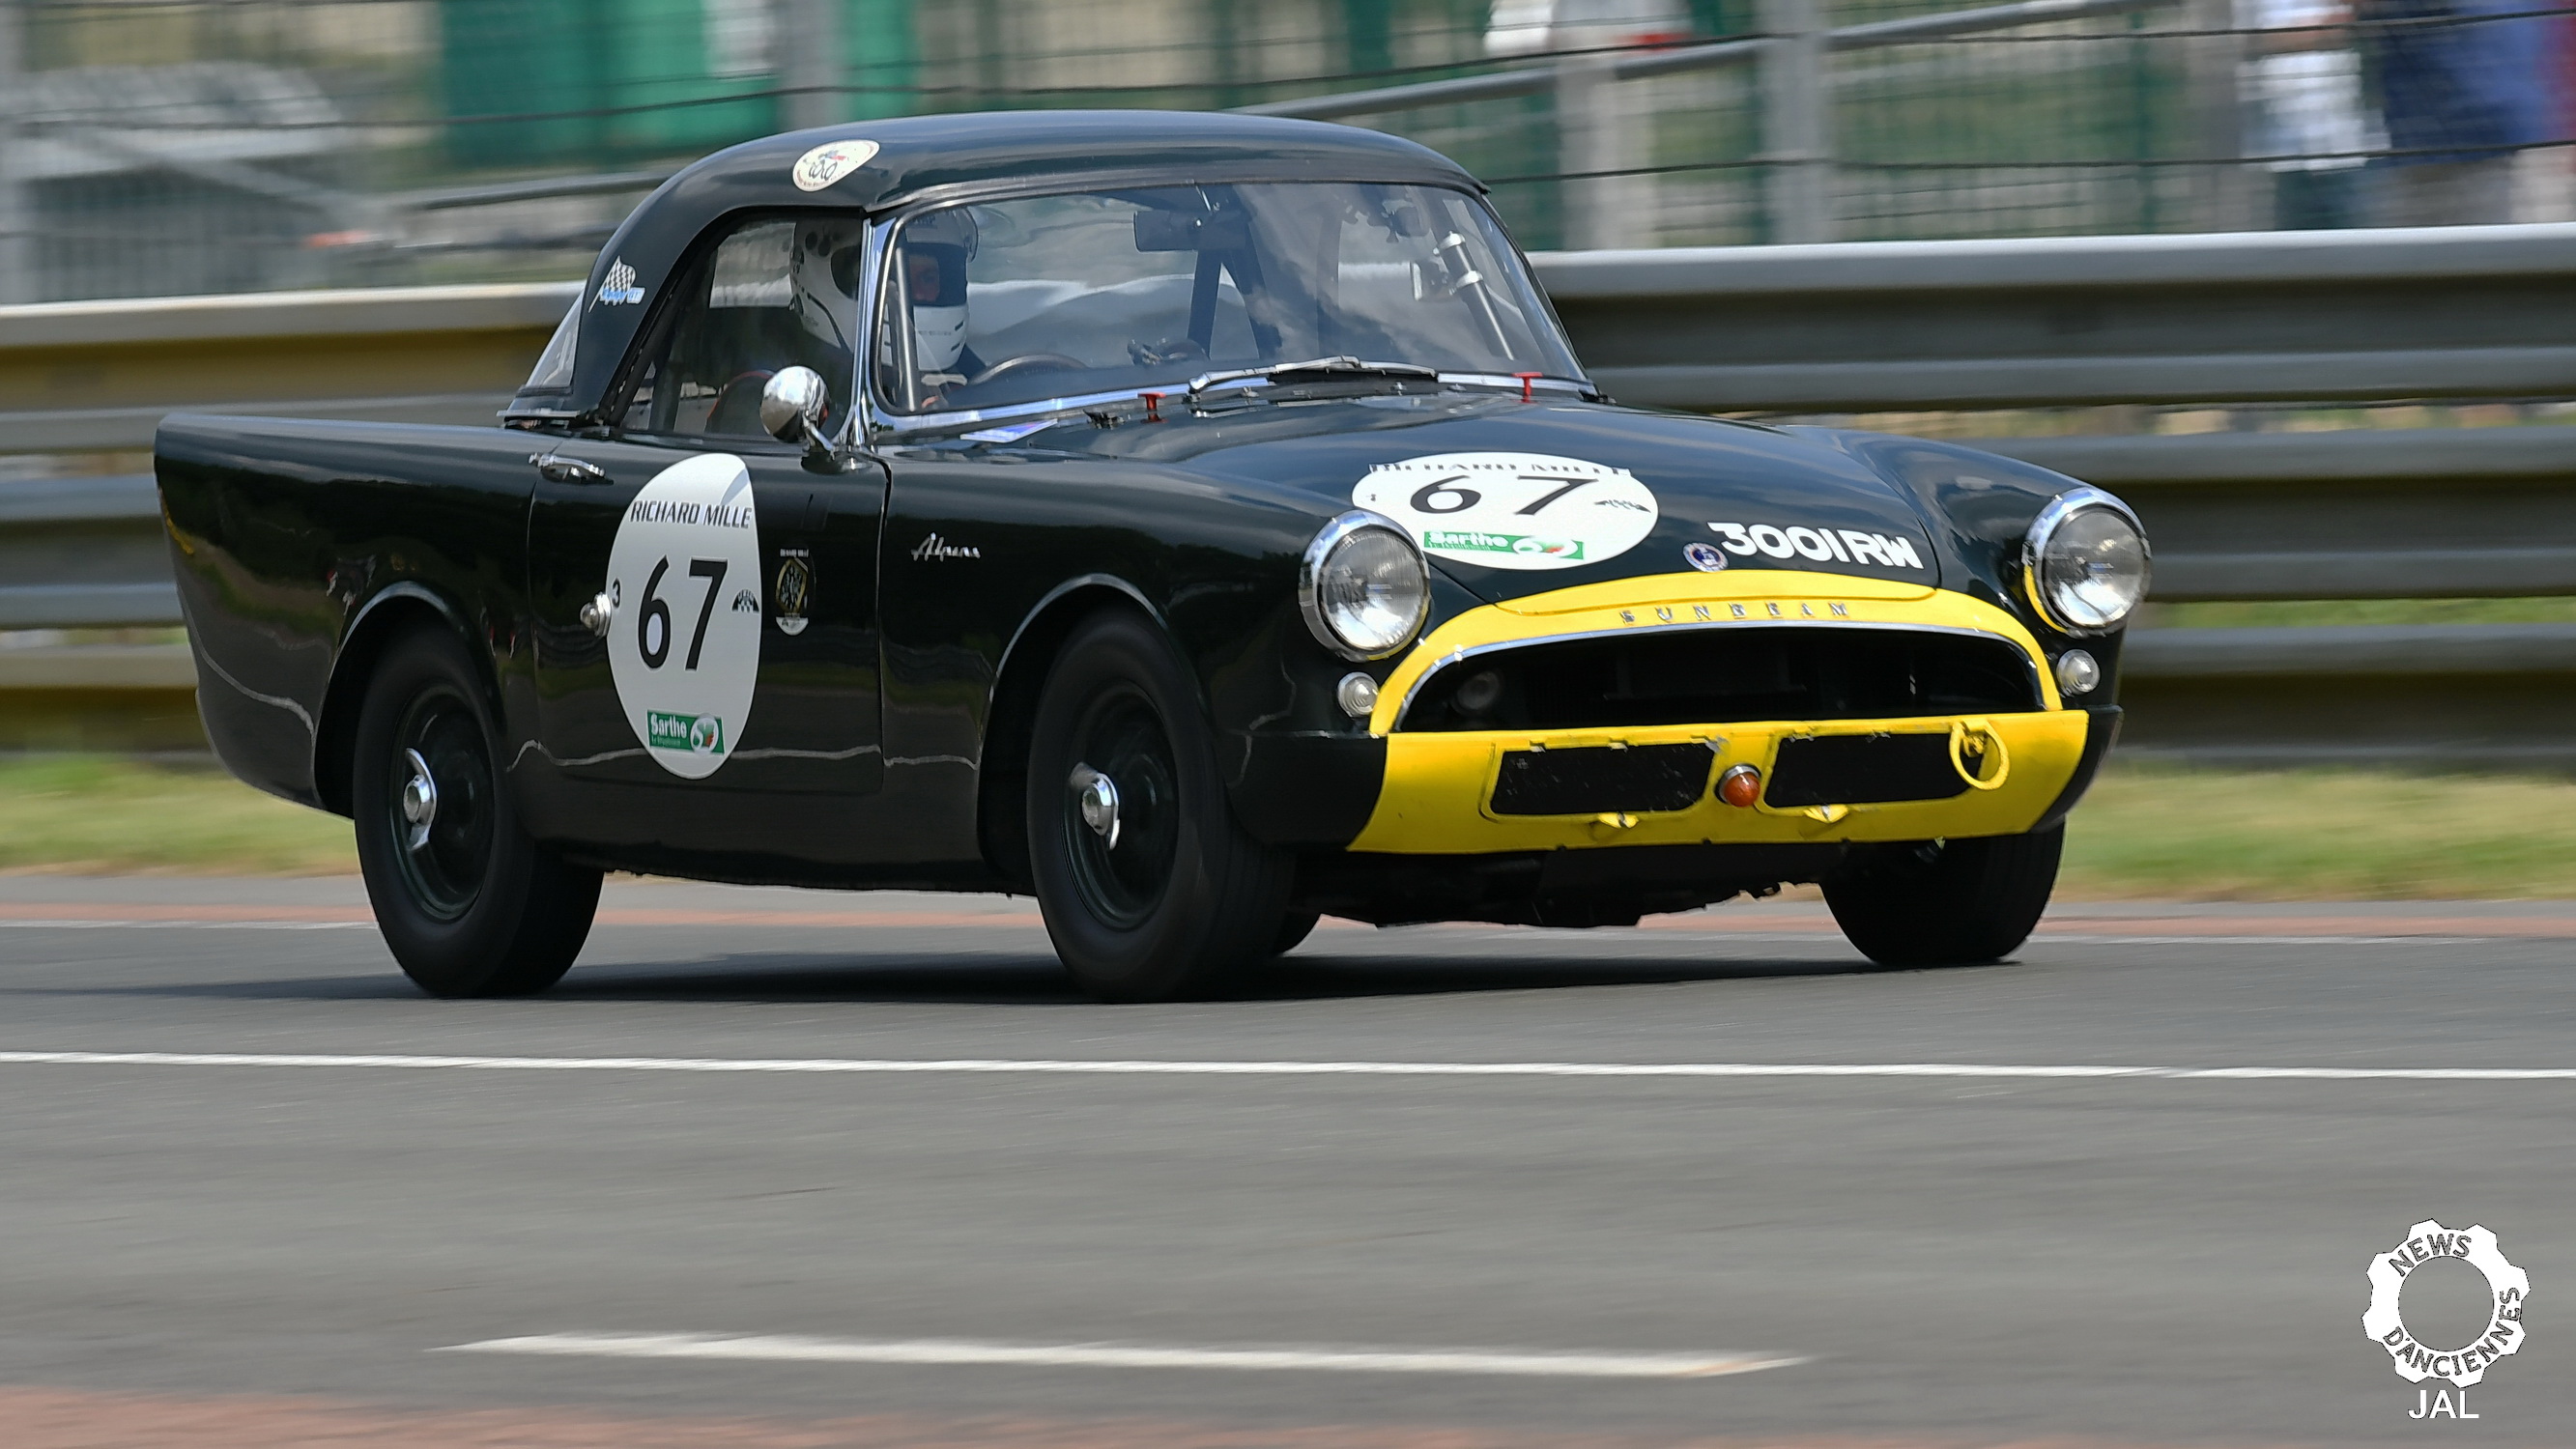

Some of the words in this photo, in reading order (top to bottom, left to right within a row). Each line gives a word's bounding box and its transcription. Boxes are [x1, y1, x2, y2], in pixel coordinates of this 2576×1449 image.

[1410, 474, 1599, 516] 67
[630, 500, 701, 525] RICHARD
[703, 503, 752, 529] MILLE
[1429, 530, 1508, 547] Sarthe
[612, 578, 621, 609] 3
[638, 554, 728, 671] 67
[1619, 602, 1849, 625] SUNBEAM
[651, 713, 687, 739] Sarthe
